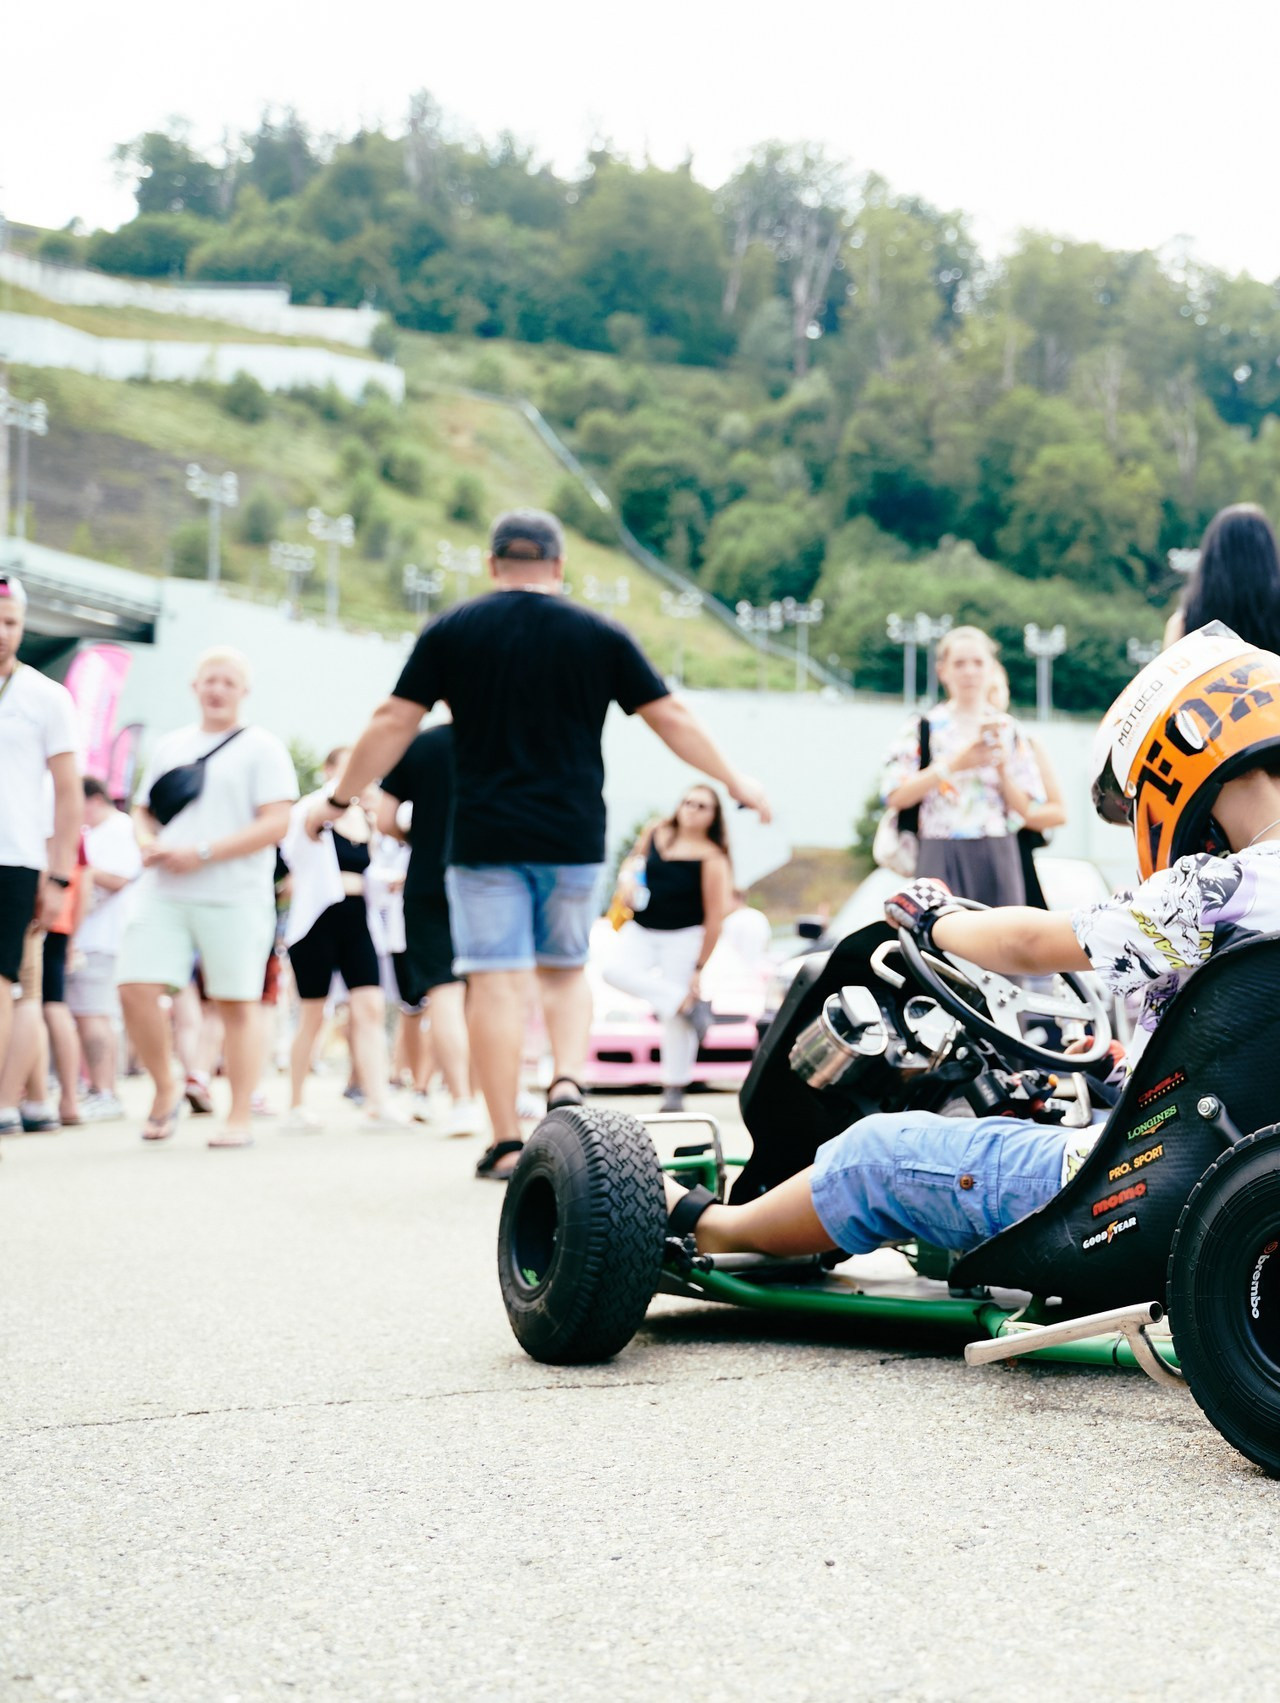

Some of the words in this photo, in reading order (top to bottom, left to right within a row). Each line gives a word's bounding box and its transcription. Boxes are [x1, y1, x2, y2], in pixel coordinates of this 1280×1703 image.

[1136, 661, 1274, 806] FOX
[1127, 1105, 1177, 1140] LONGINES
[1109, 1162, 1132, 1181] PRO.
[1133, 1145, 1163, 1168] SPORT
[1250, 1254, 1270, 1319] brembo
